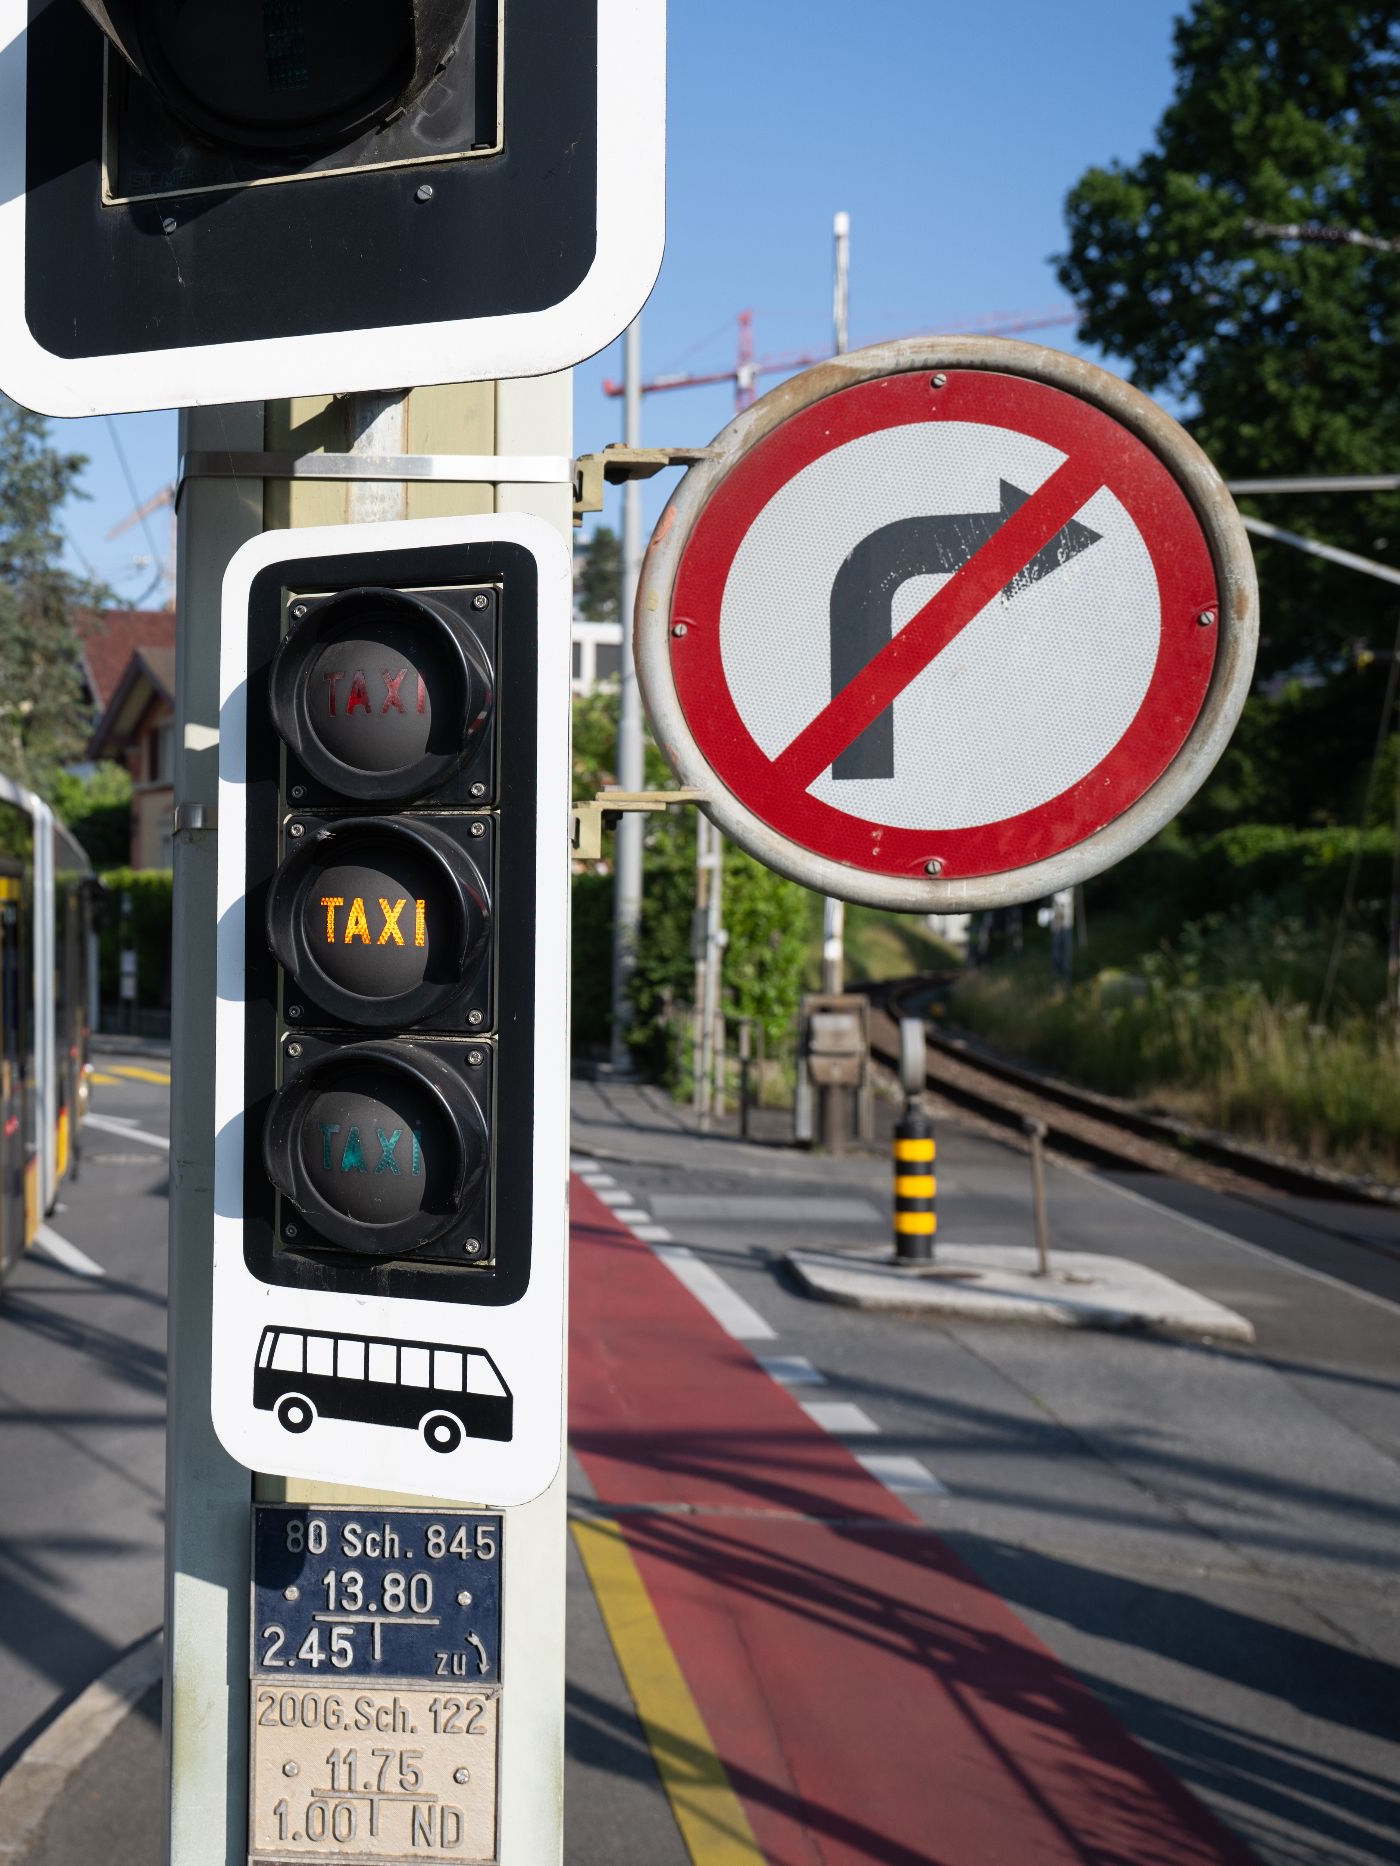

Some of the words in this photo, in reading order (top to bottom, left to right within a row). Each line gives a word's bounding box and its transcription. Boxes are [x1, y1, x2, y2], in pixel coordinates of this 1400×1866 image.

[324, 668, 426, 718] TAXI
[319, 897, 426, 947] TAXI
[319, 1122, 423, 1177] TAXI
[286, 1520, 328, 1555] 80
[343, 1521, 413, 1559] Sch.
[427, 1523, 497, 1560] 845
[323, 1569, 434, 1614] 13.80
[262, 1625, 355, 1669] 2.45
[436, 1651, 467, 1676] zu
[429, 1696, 488, 1735] 122
[326, 1747, 425, 1793] 11.75
[274, 1797, 358, 1843] 1.00
[411, 1804, 466, 1849] ND
